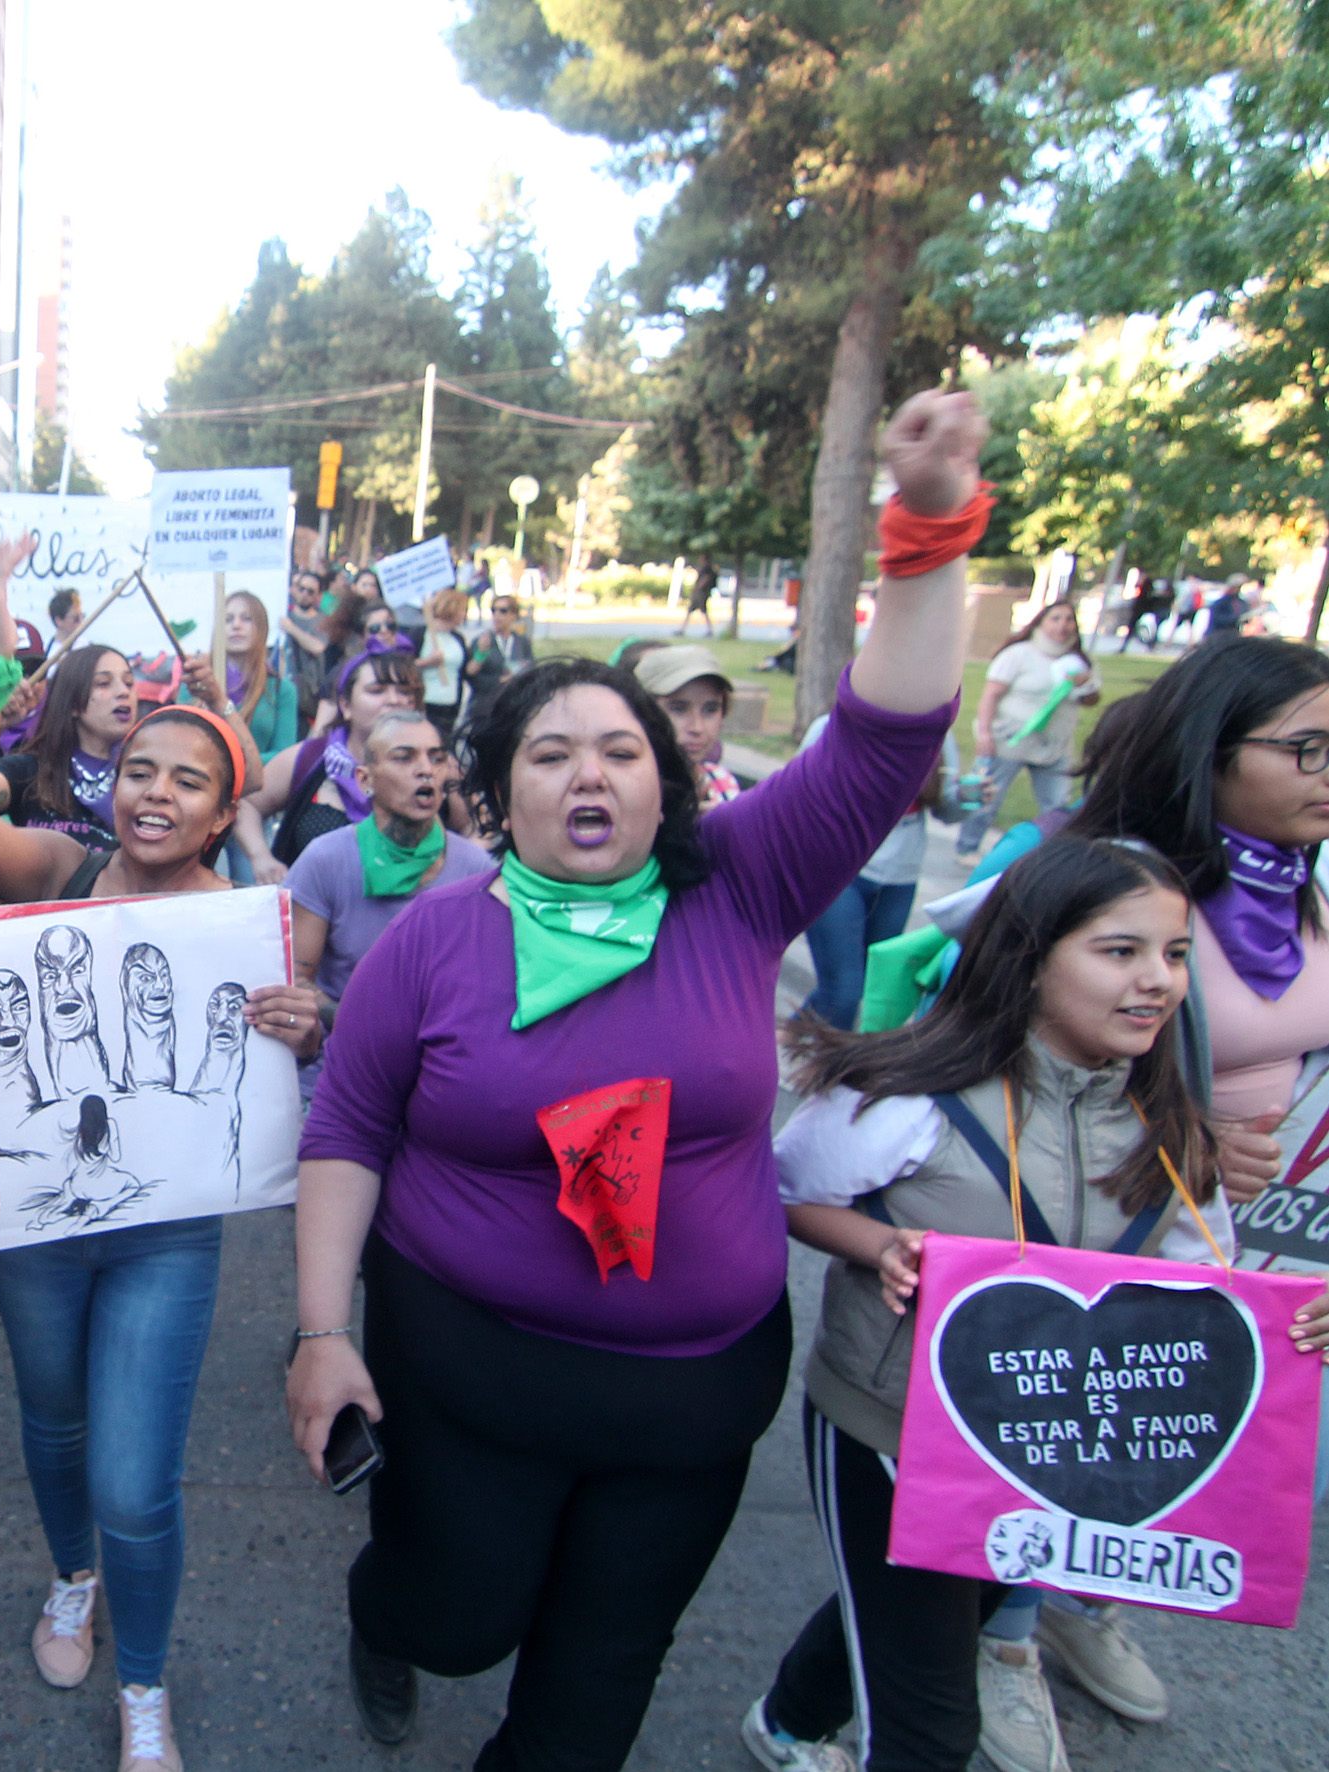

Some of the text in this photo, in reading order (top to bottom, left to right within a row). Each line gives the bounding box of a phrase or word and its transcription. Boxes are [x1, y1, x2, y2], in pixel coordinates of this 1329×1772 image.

[173, 489, 221, 501] ABORTO
[166, 507, 275, 523] LIBRE Y FEMINISTA
[155, 527, 283, 543] EN CUALQUIER LUGAR!
[988, 1341, 1208, 1374] ESTAR A FAVOR
[1016, 1366, 1185, 1396] DEL ABORTO
[1087, 1393, 1119, 1415] ES
[998, 1413, 1219, 1443] ESTAR A FAVOR
[1025, 1438, 1197, 1466] DE LA VIDA
[1064, 1518, 1236, 1597] LIBERTAS
